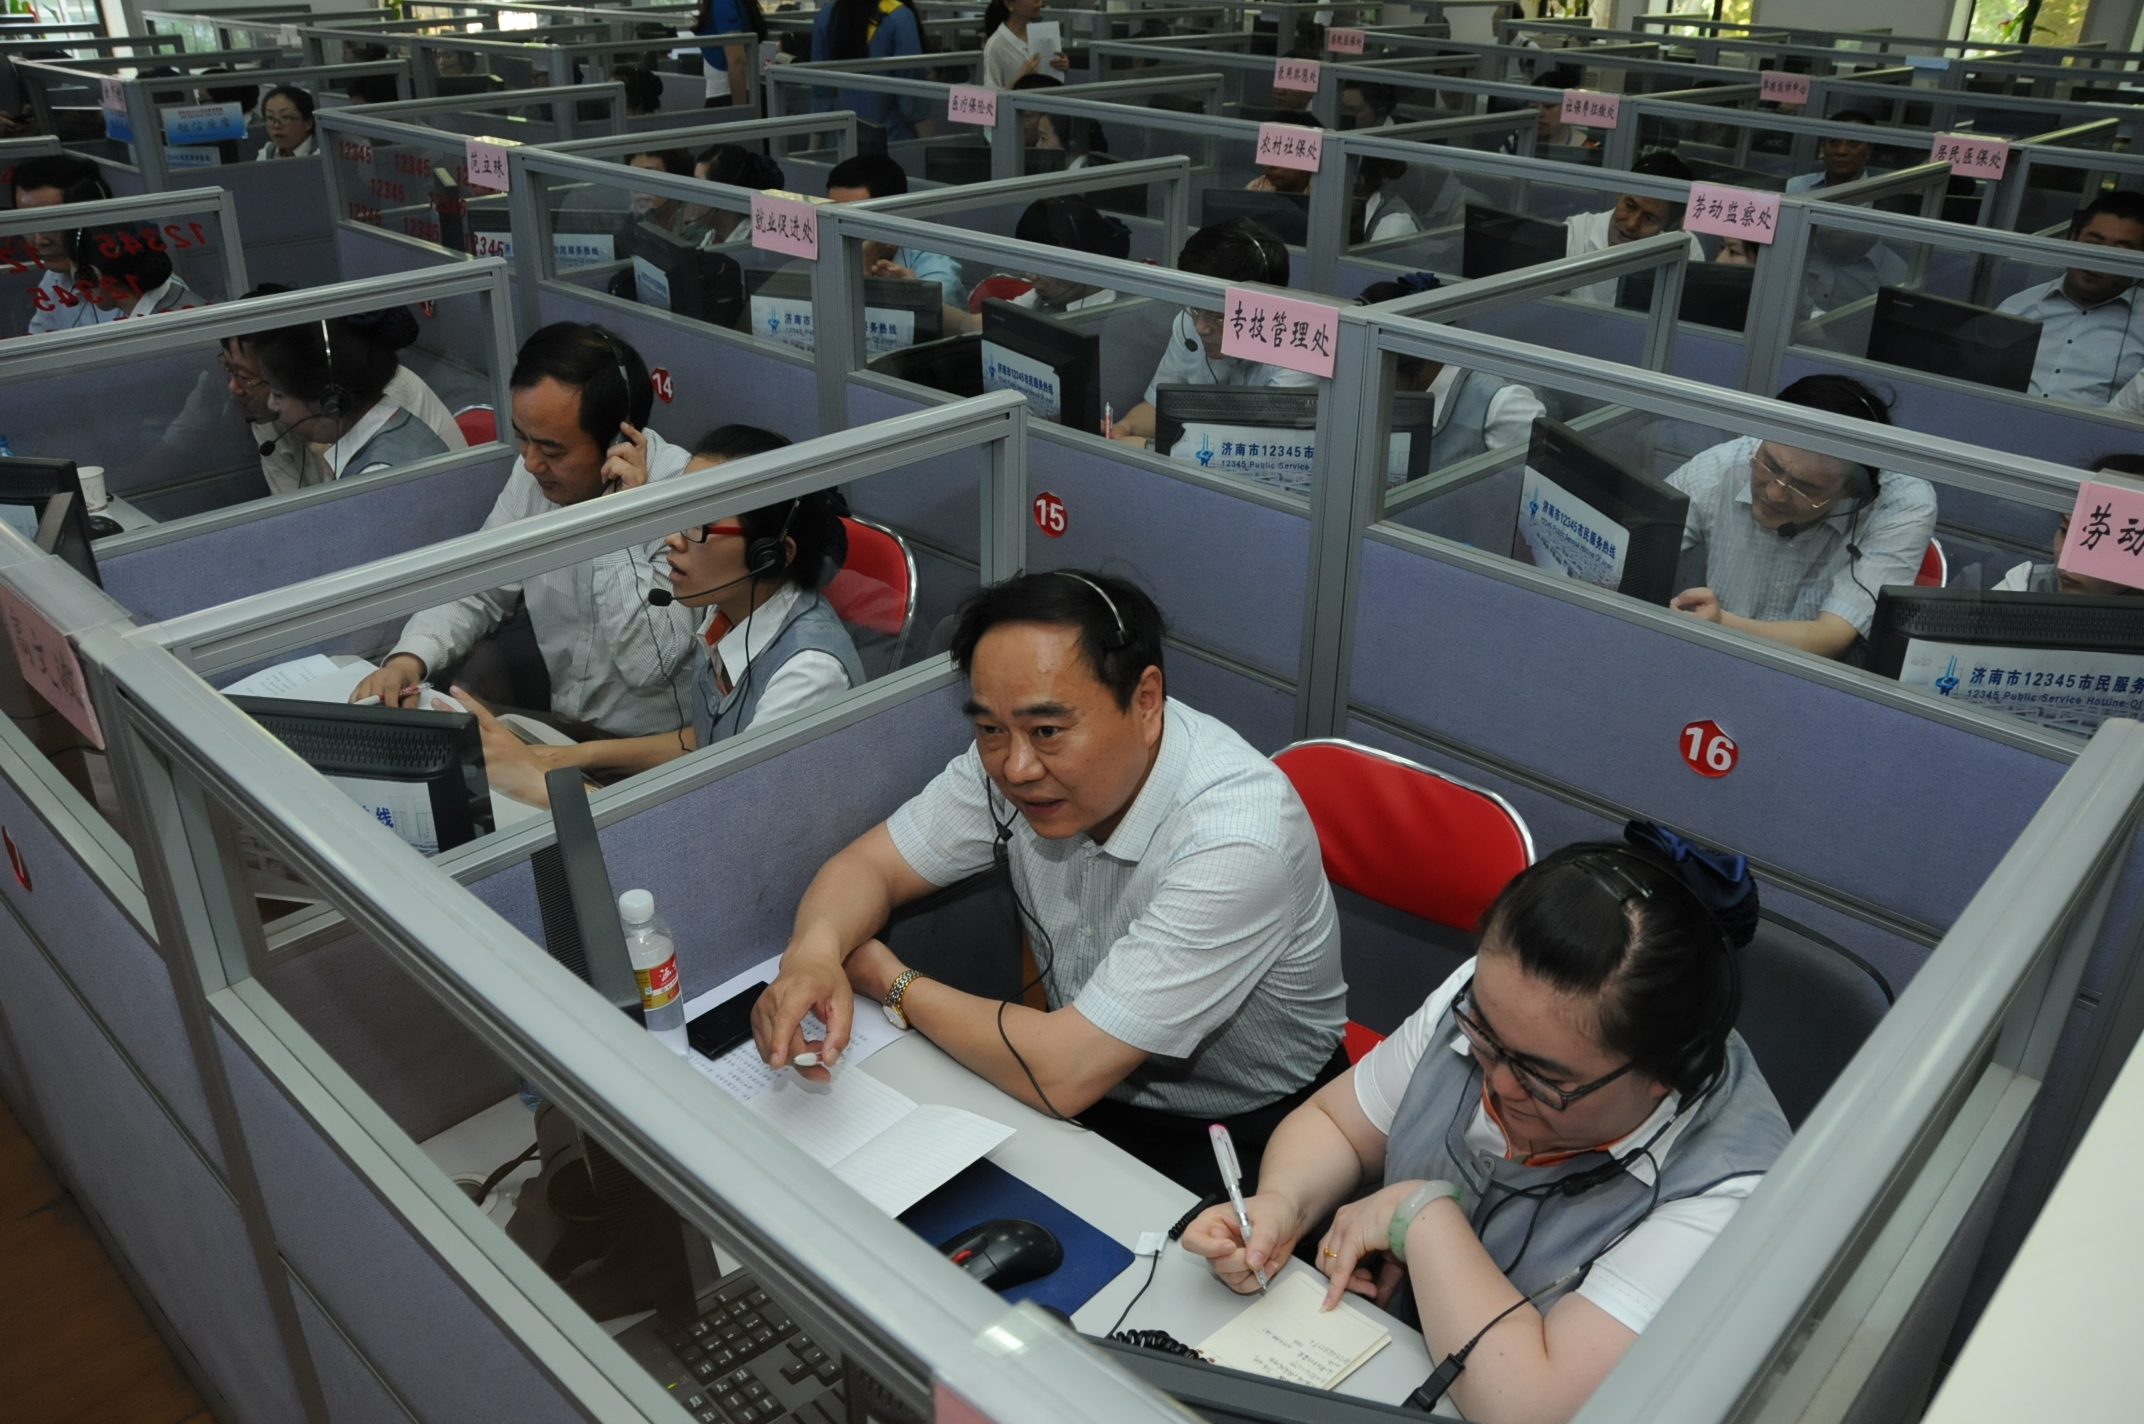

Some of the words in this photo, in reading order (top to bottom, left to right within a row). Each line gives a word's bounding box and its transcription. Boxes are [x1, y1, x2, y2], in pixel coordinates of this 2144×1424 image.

[339, 141, 372, 165] 12345
[1260, 132, 1317, 160] 农村社保处
[1935, 145, 2002, 169] 居民医保处
[395, 153, 431, 177] 12345
[1693, 193, 1771, 230] 劳动监察处
[755, 207, 813, 243] 就业促进处
[785, 313, 811, 326] 济南市
[1230, 300, 1329, 357] 专技管理处
[652, 373, 673, 398] 14
[1221, 441, 1315, 459] 济南市12345市
[1249, 462, 1275, 470] Public
[1278, 463, 1310, 471] Service
[1036, 499, 1065, 532] 15
[2079, 502, 2144, 557] 劳动
[1967, 690, 1999, 700] 12345
[2003, 691, 2037, 702] Public
[2041, 694, 2082, 705] Service
[2087, 696, 2125, 708] Hotline
[1685, 727, 1735, 771] 16
